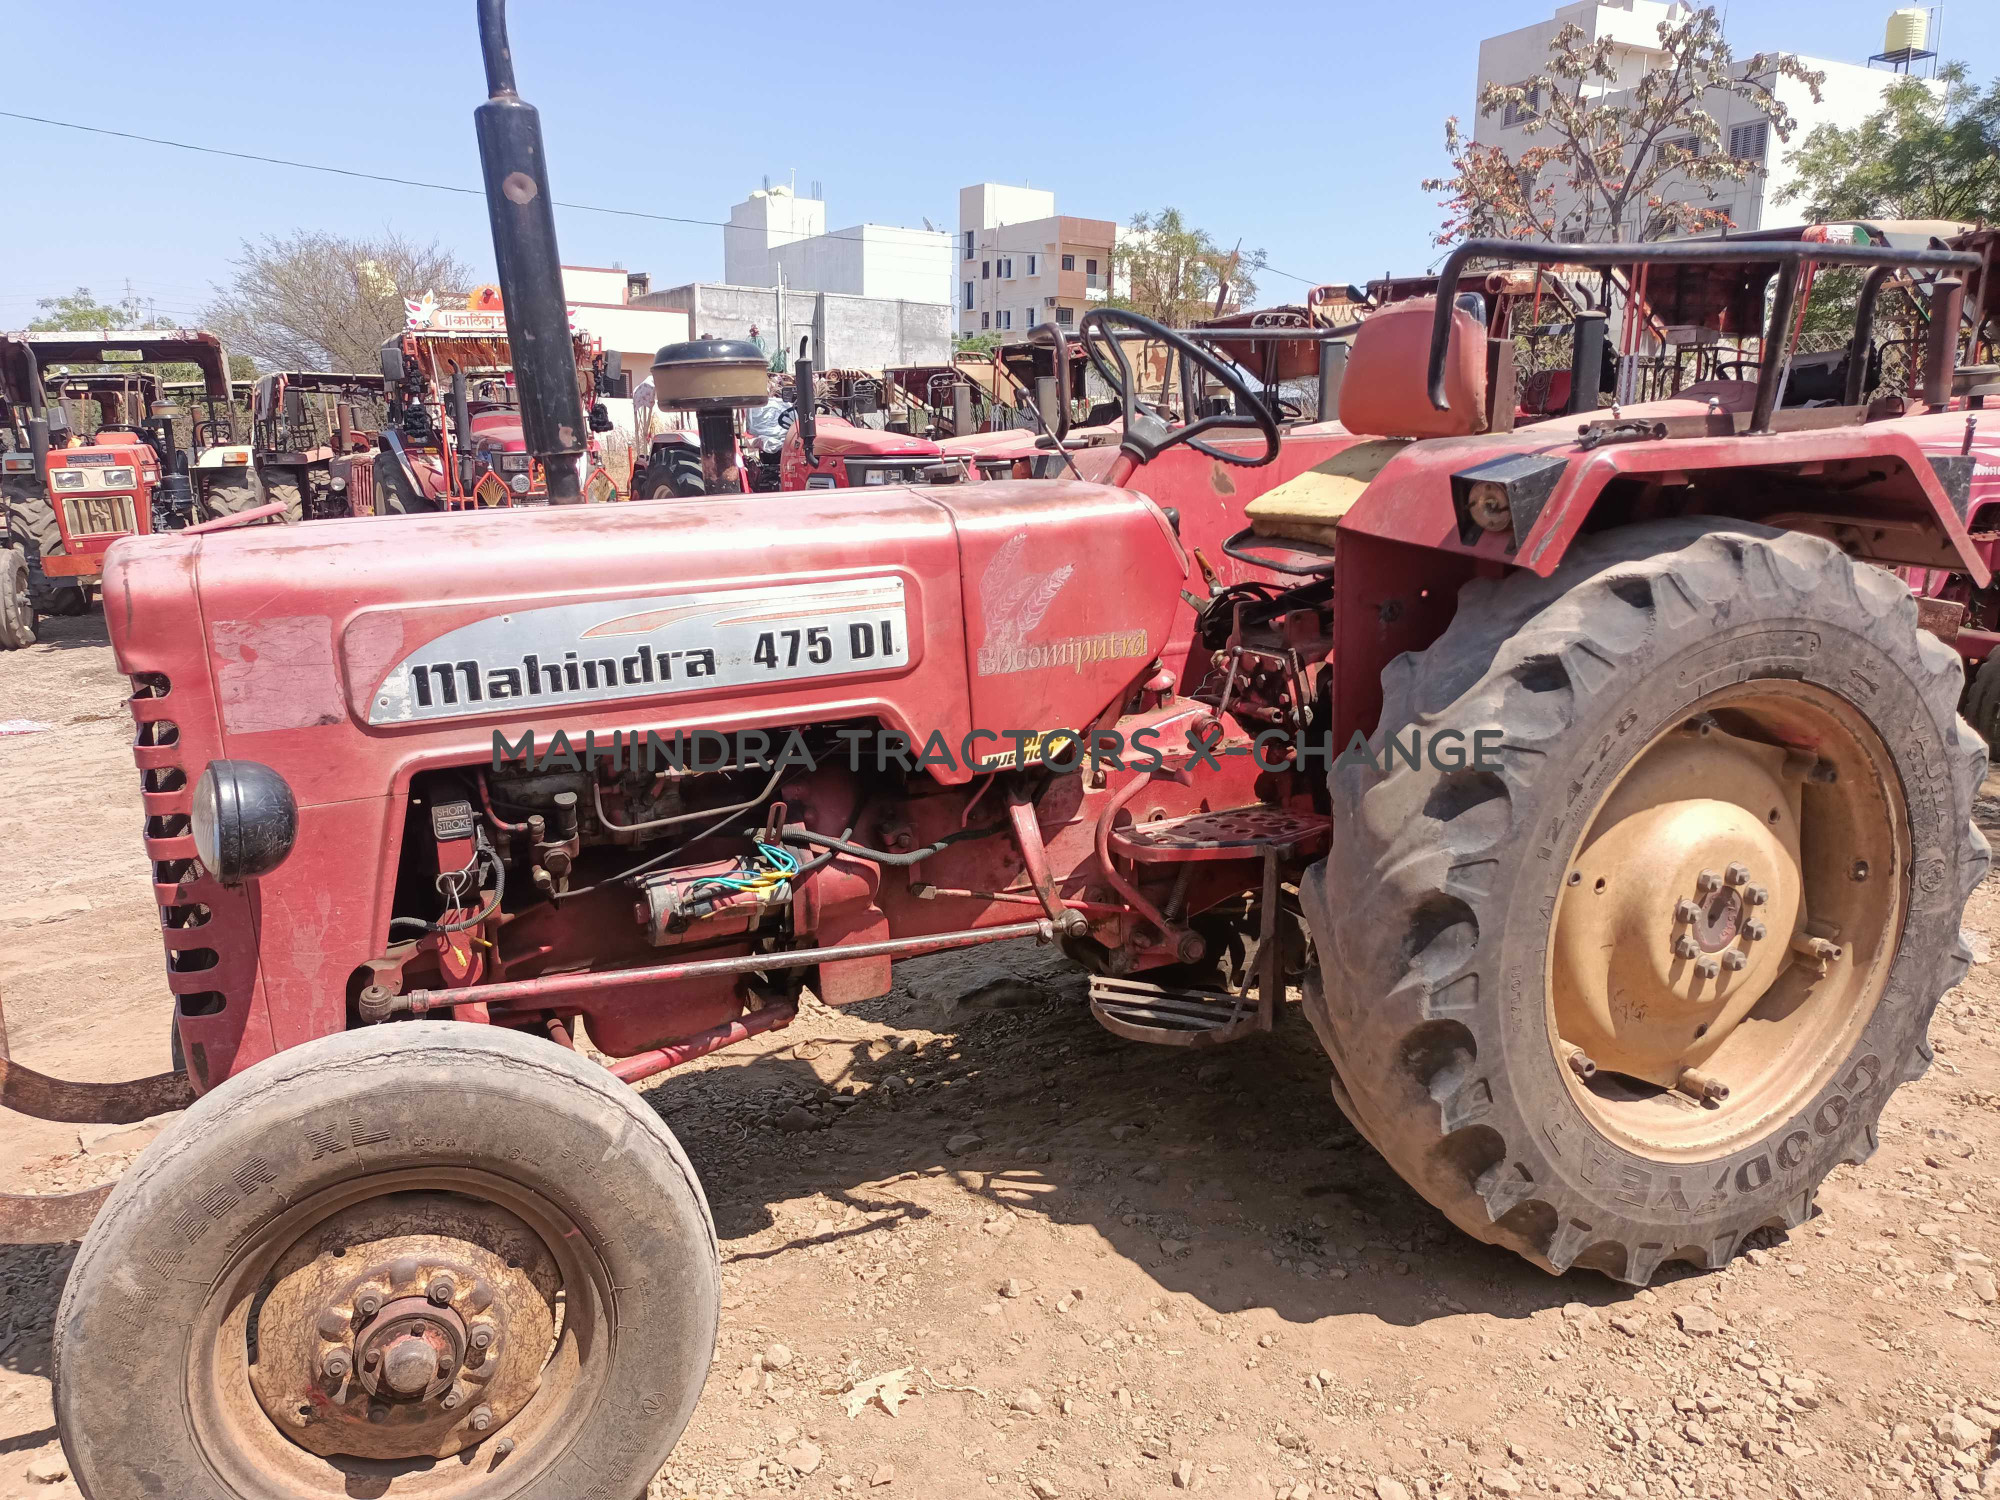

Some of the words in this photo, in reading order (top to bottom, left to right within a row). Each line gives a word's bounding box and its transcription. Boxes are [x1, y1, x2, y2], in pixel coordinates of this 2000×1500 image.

[752, 626, 832, 669] 475
[848, 619, 893, 661] DI
[436, 805, 467, 817] SHORT
[437, 818, 471, 831] STROKE
[304, 1116, 391, 1161] XL
